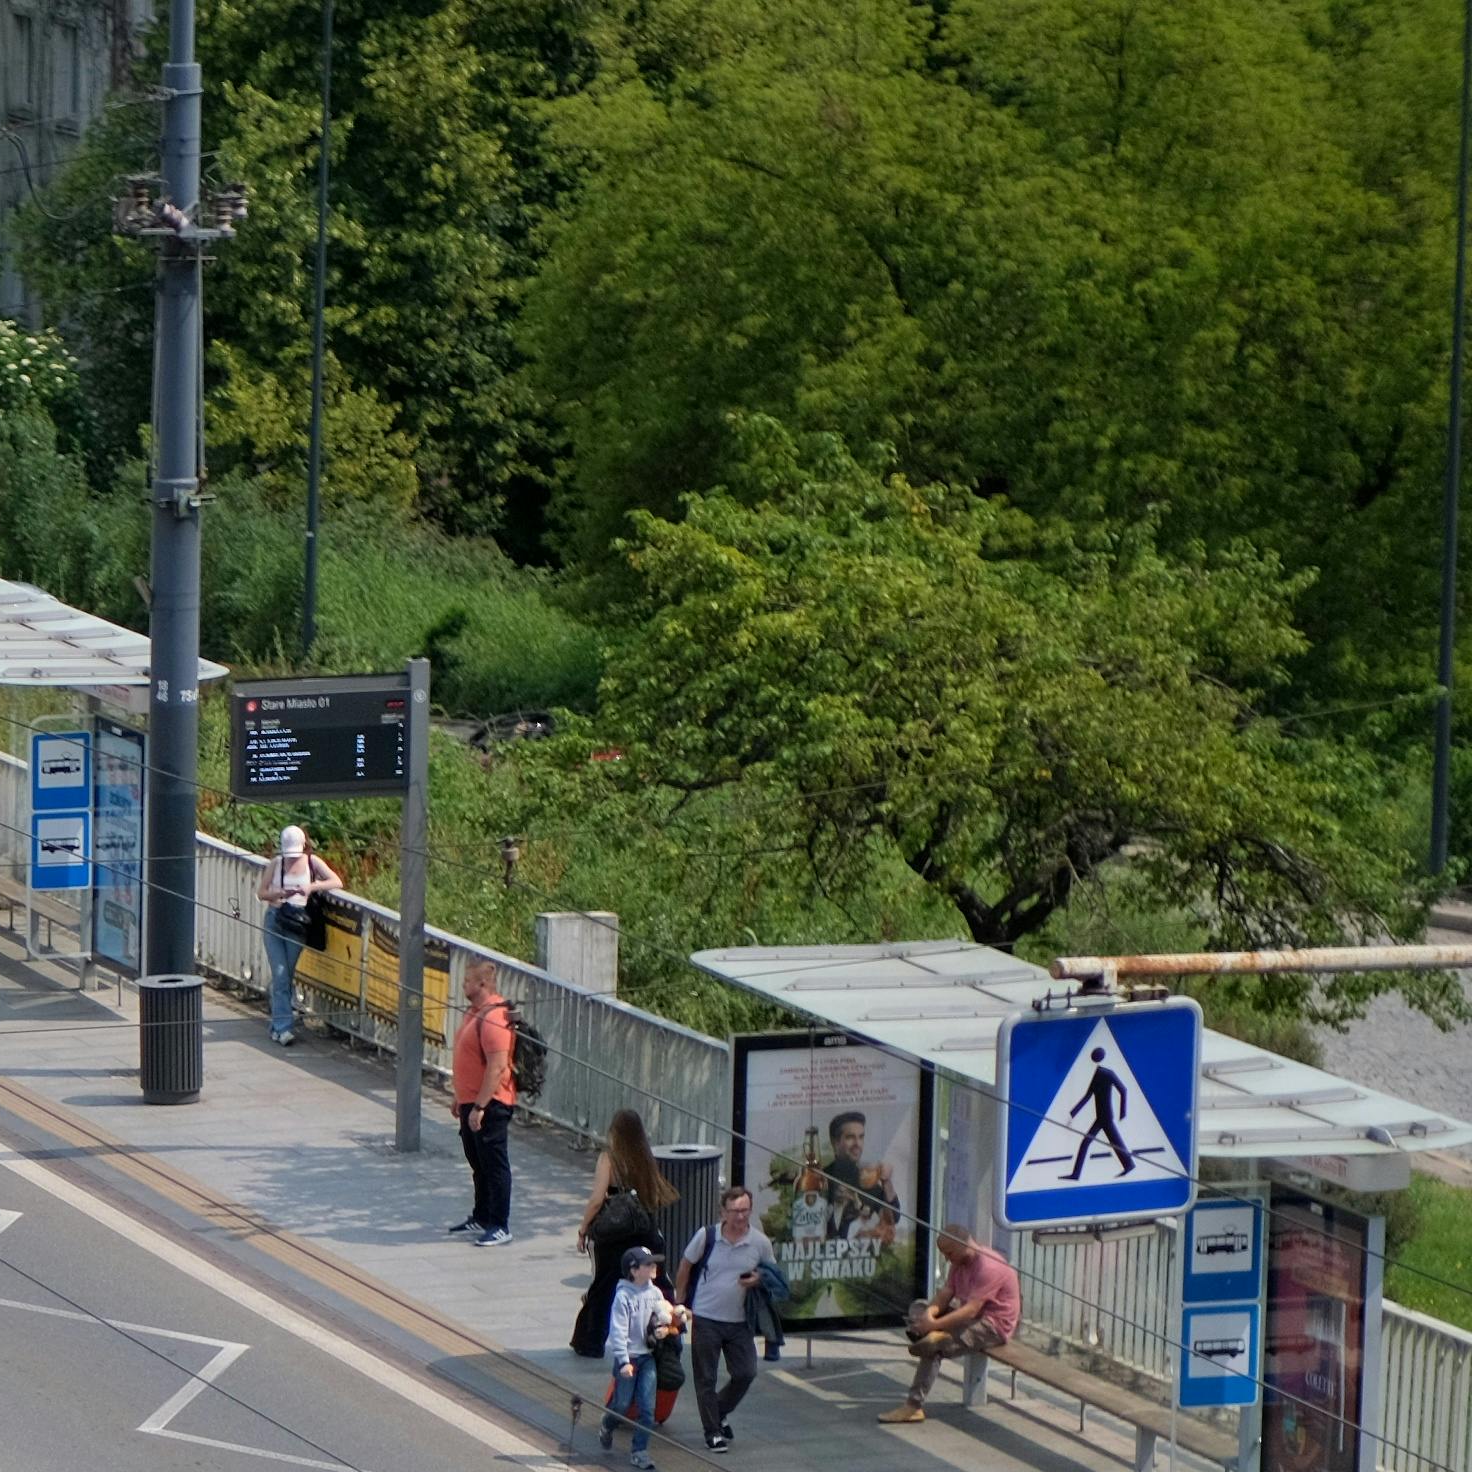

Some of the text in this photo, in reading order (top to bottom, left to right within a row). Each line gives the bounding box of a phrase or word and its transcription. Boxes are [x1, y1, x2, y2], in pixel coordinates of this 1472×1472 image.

[260, 696, 330, 711] Stare Miasto 01
[823, 1036, 847, 1046] ams
[781, 1238, 882, 1261] NAJLEPSZY
[788, 1258, 876, 1280] W SMAKU
